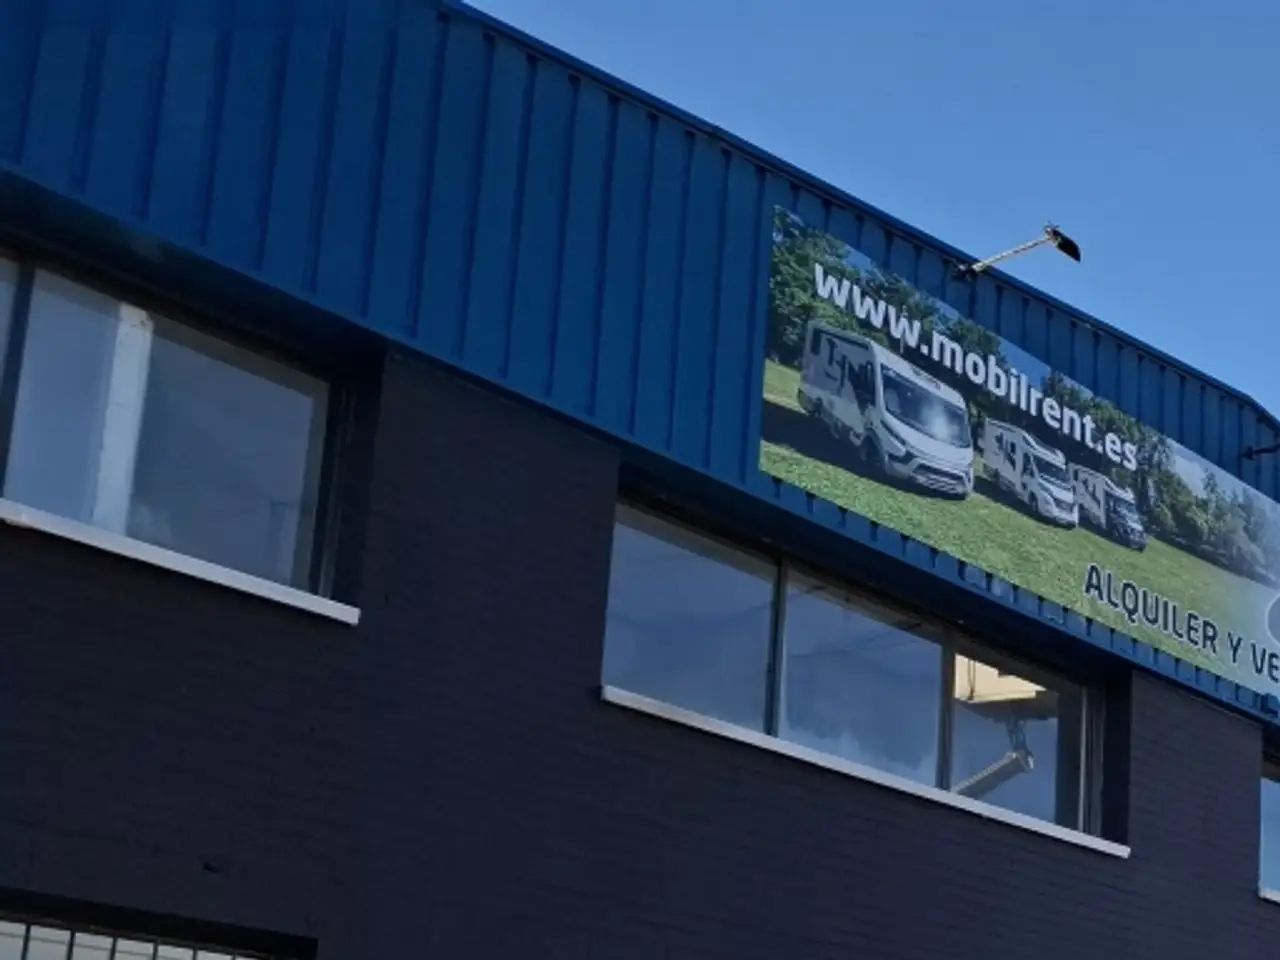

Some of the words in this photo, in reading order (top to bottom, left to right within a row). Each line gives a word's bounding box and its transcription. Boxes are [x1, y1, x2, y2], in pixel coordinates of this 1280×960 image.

[814, 263, 1138, 472] www.mobilrent.es
[1084, 563, 1218, 653] ALQUILER
[1228, 632, 1244, 663] Y
